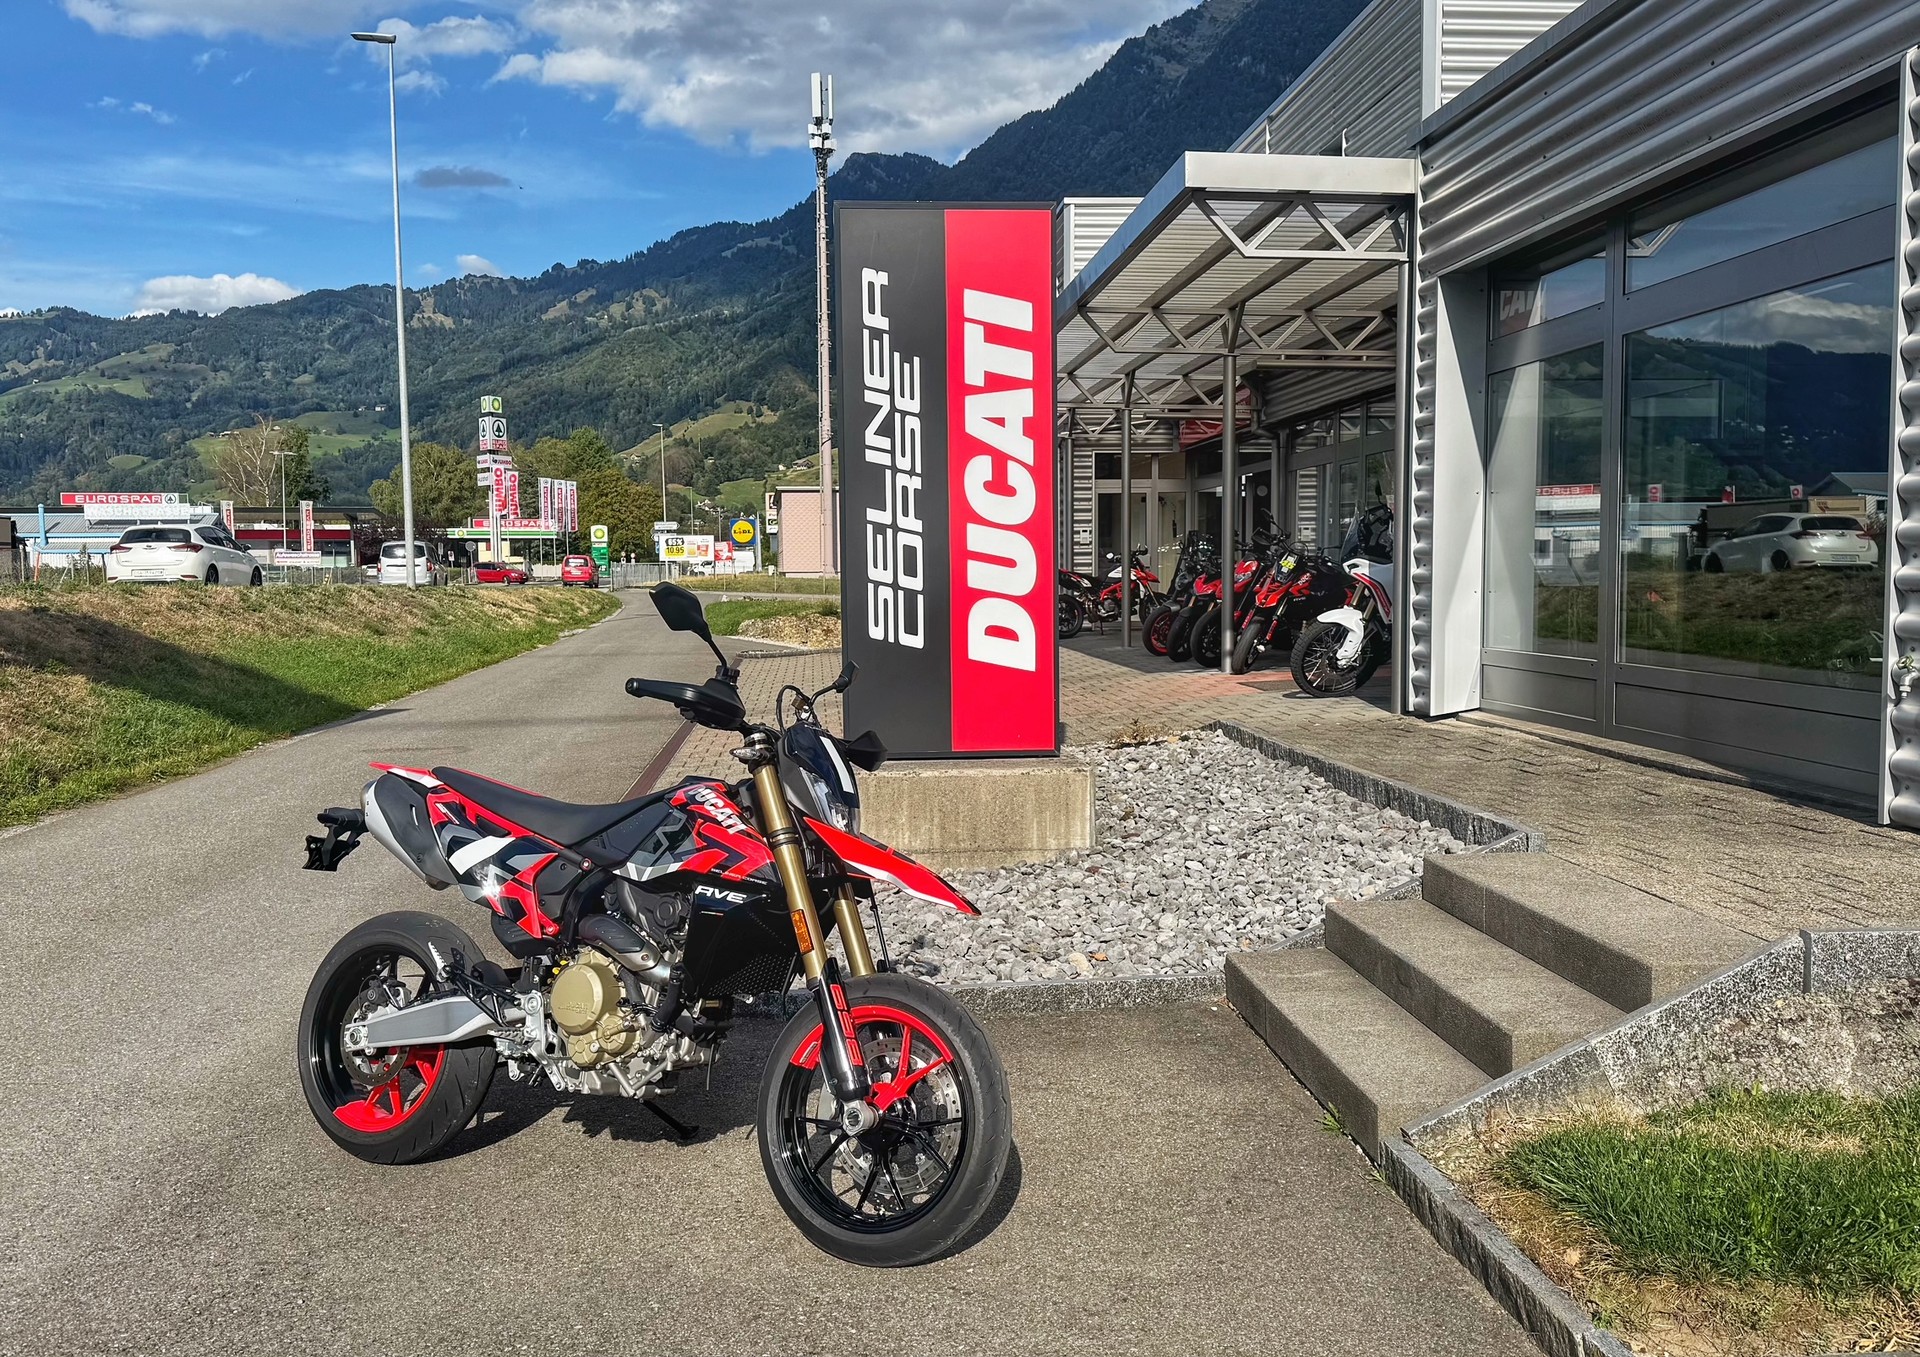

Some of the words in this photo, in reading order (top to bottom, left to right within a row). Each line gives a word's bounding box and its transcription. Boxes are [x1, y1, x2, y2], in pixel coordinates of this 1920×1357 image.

[509, 473, 519, 517] JUMBO
[861, 267, 894, 643] SELINER
[964, 289, 1036, 671] DUCATI
[75, 494, 162, 503] EUROSPAR
[893, 352, 925, 649] CORSE
[688, 786, 748, 834] DUCATI
[830, 984, 864, 1066] 698
